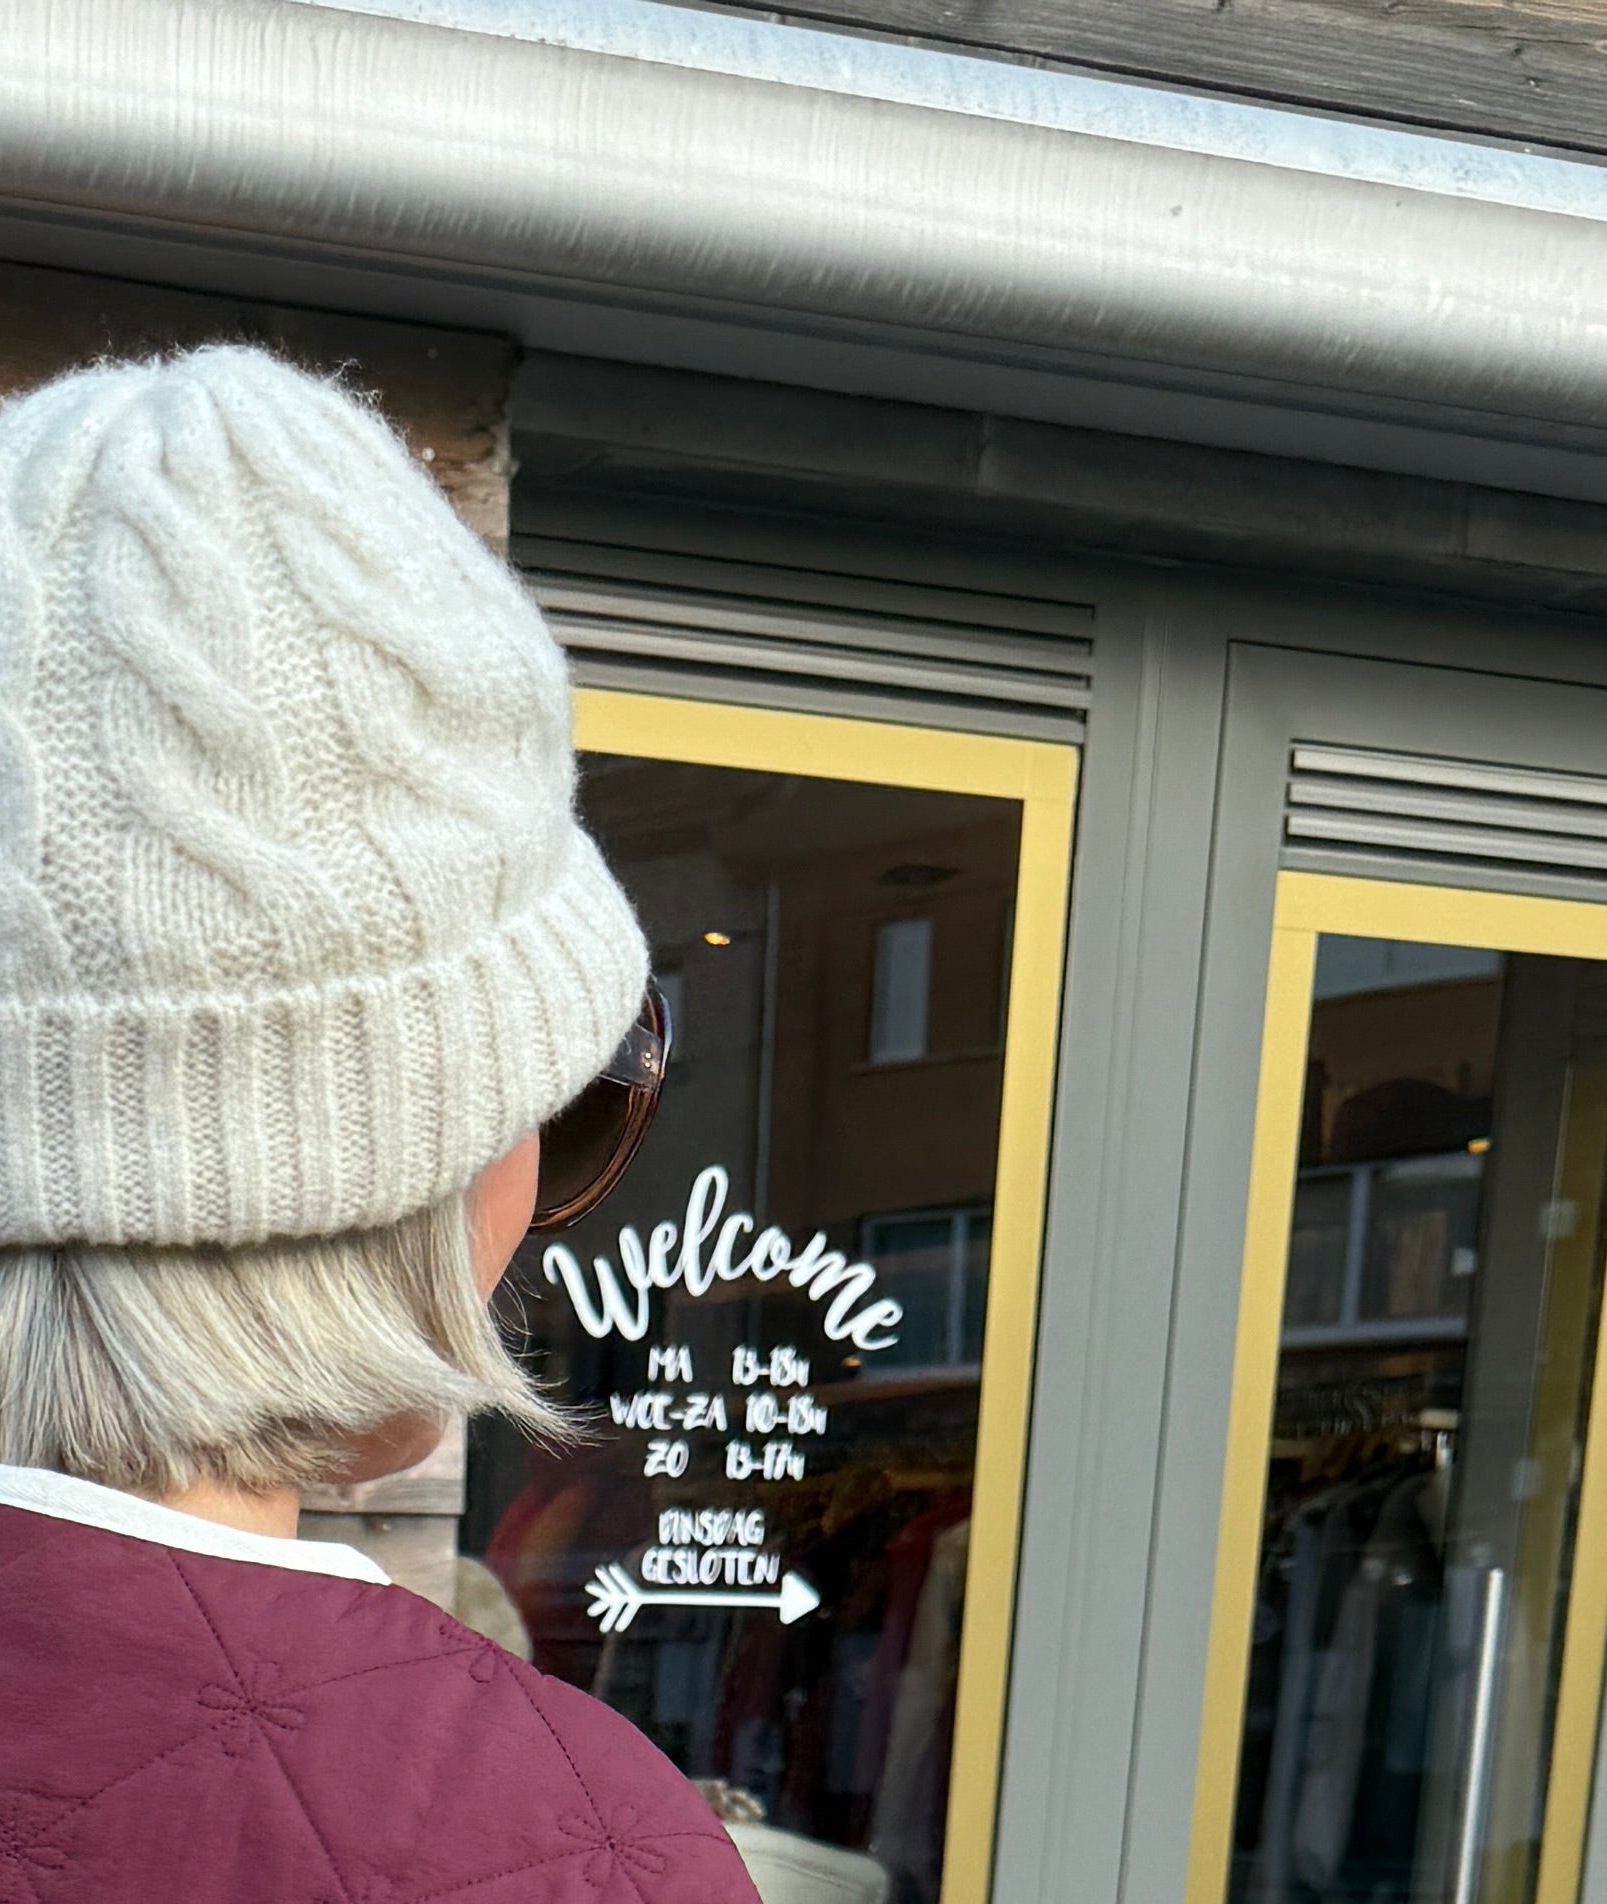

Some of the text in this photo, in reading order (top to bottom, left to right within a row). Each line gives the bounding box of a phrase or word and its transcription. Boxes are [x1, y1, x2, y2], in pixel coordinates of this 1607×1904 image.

[542, 1165, 904, 1351] Welcome
[648, 1345, 693, 1383] MA
[643, 1440, 690, 1478] ZO
[658, 1508, 765, 1546] DINSDAG
[641, 1547, 780, 1586] GESLOTEN
